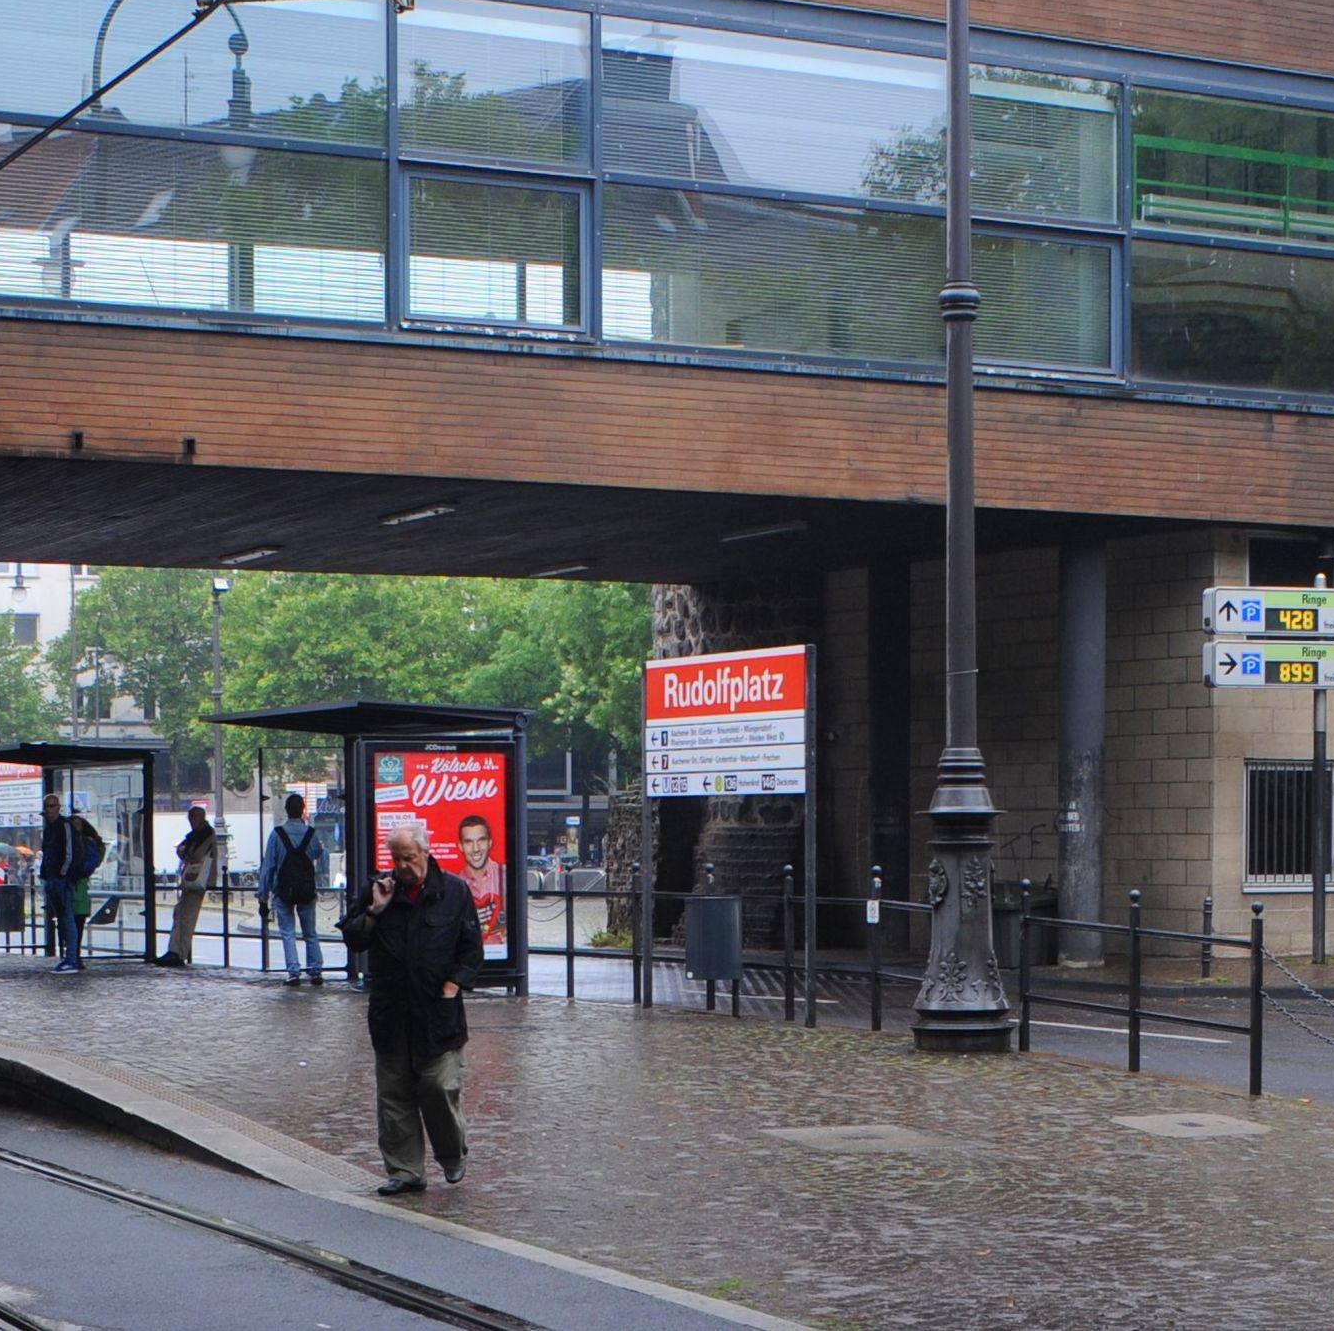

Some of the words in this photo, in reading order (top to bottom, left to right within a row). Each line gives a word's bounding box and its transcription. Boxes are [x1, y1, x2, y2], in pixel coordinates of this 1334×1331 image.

[1302, 594, 1327, 607] Ringe
[1279, 610, 1314, 630] 428
[1302, 647, 1327, 660] Ringe
[1279, 663, 1314, 683] 899
[664, 666, 784, 712] Rudolfplatz
[431, 756, 482, 774] Kölsche
[412, 774, 498, 807] Wiesn
